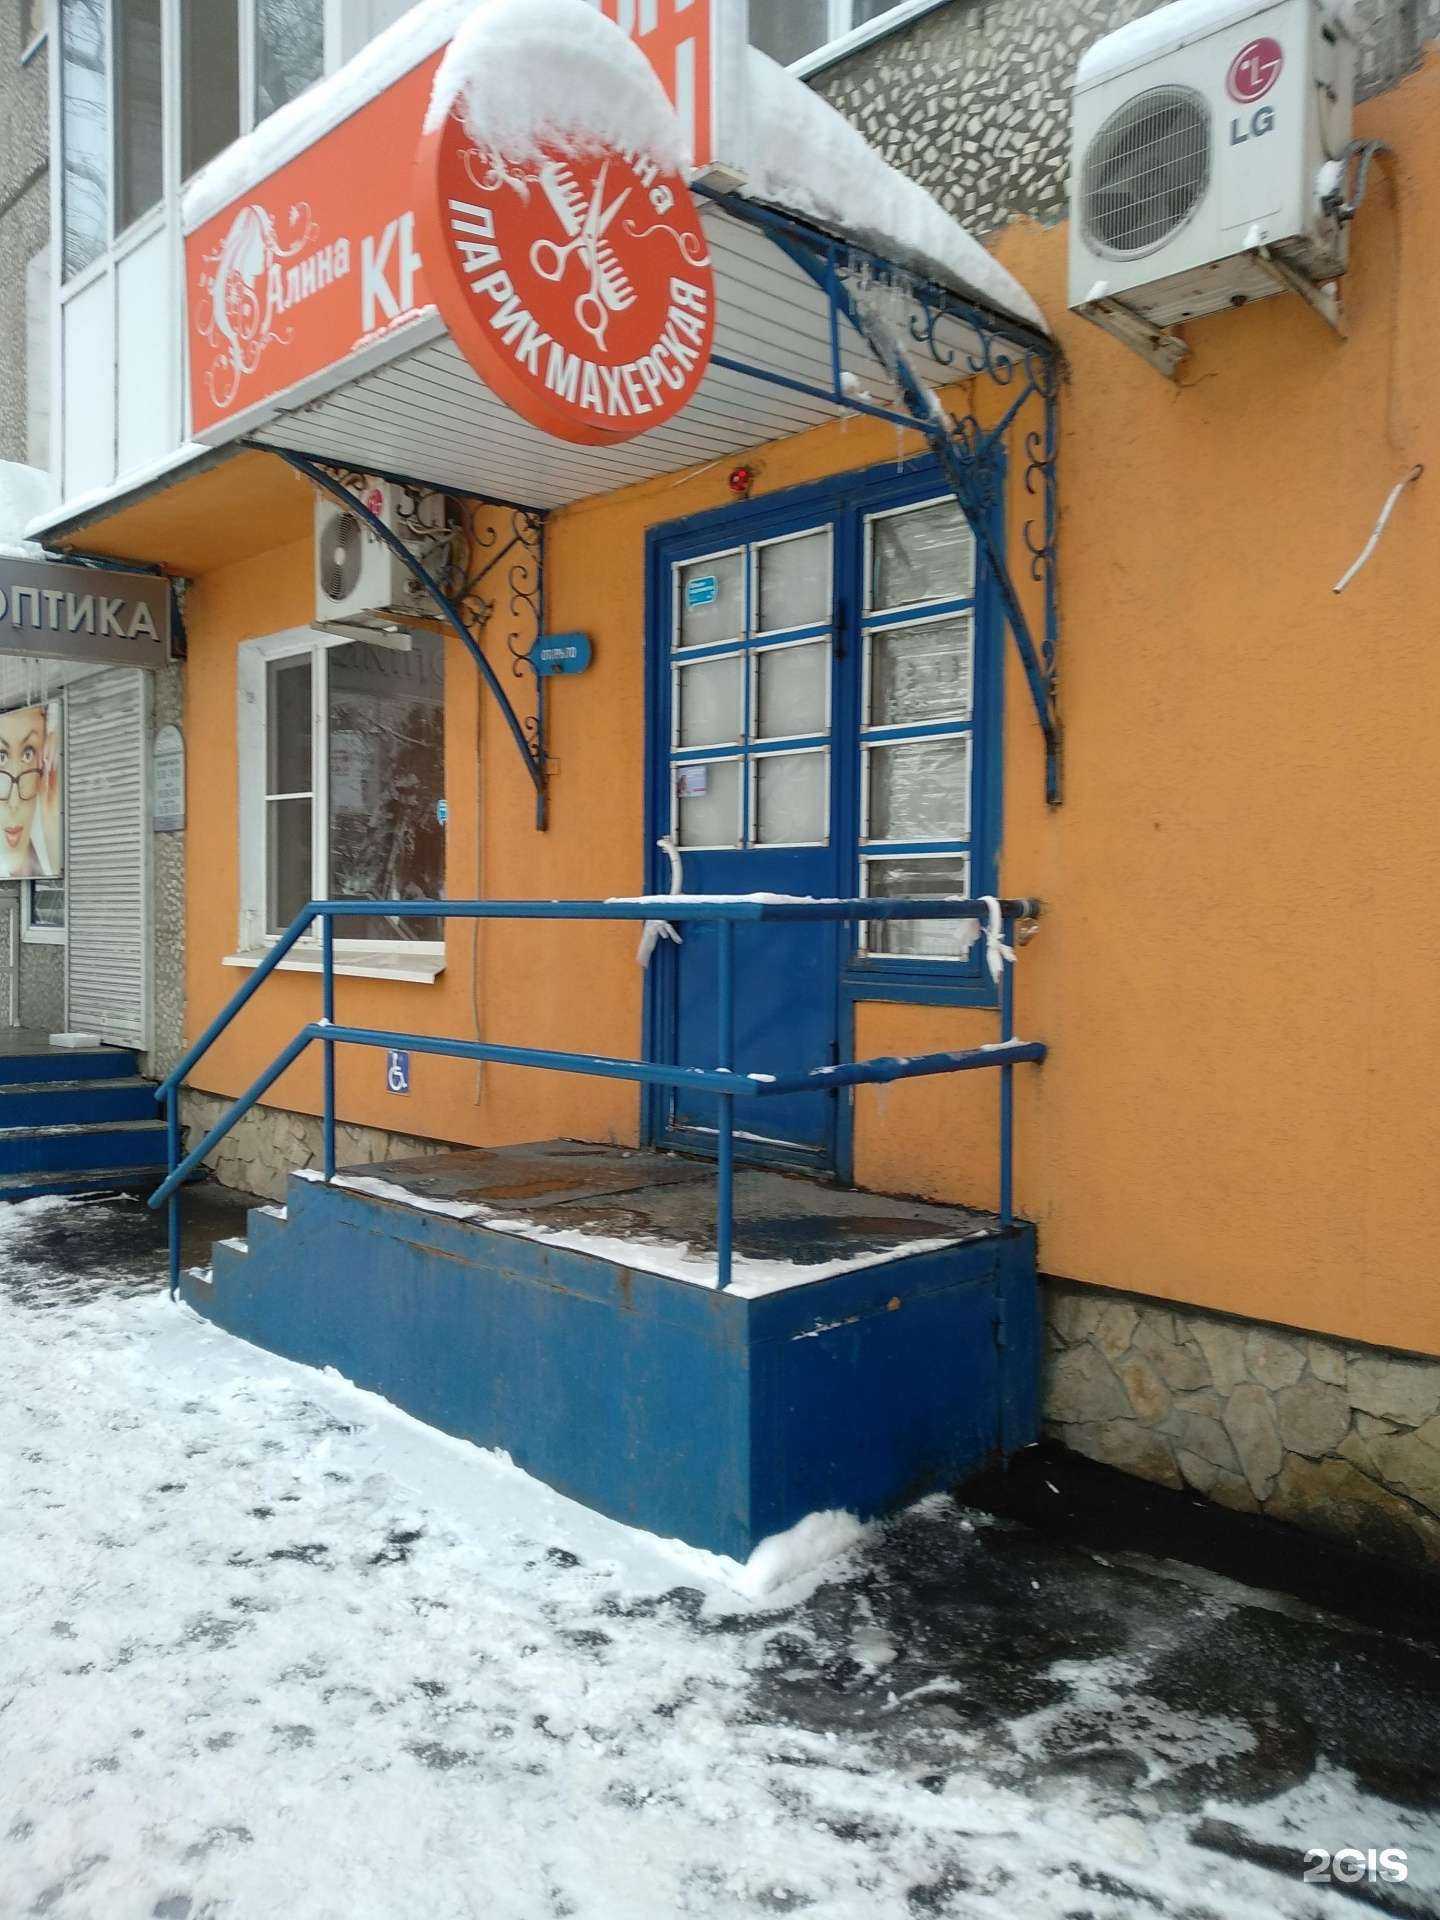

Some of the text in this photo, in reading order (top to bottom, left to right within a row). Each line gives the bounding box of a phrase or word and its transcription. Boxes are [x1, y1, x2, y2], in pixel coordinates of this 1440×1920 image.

[1229, 105, 1275, 146] LG
[267, 236, 350, 315] Алина
[448, 198, 708, 416] ПАРИКМАХЕРСКАЯ
[0, 585, 161, 643] ПТИКА
